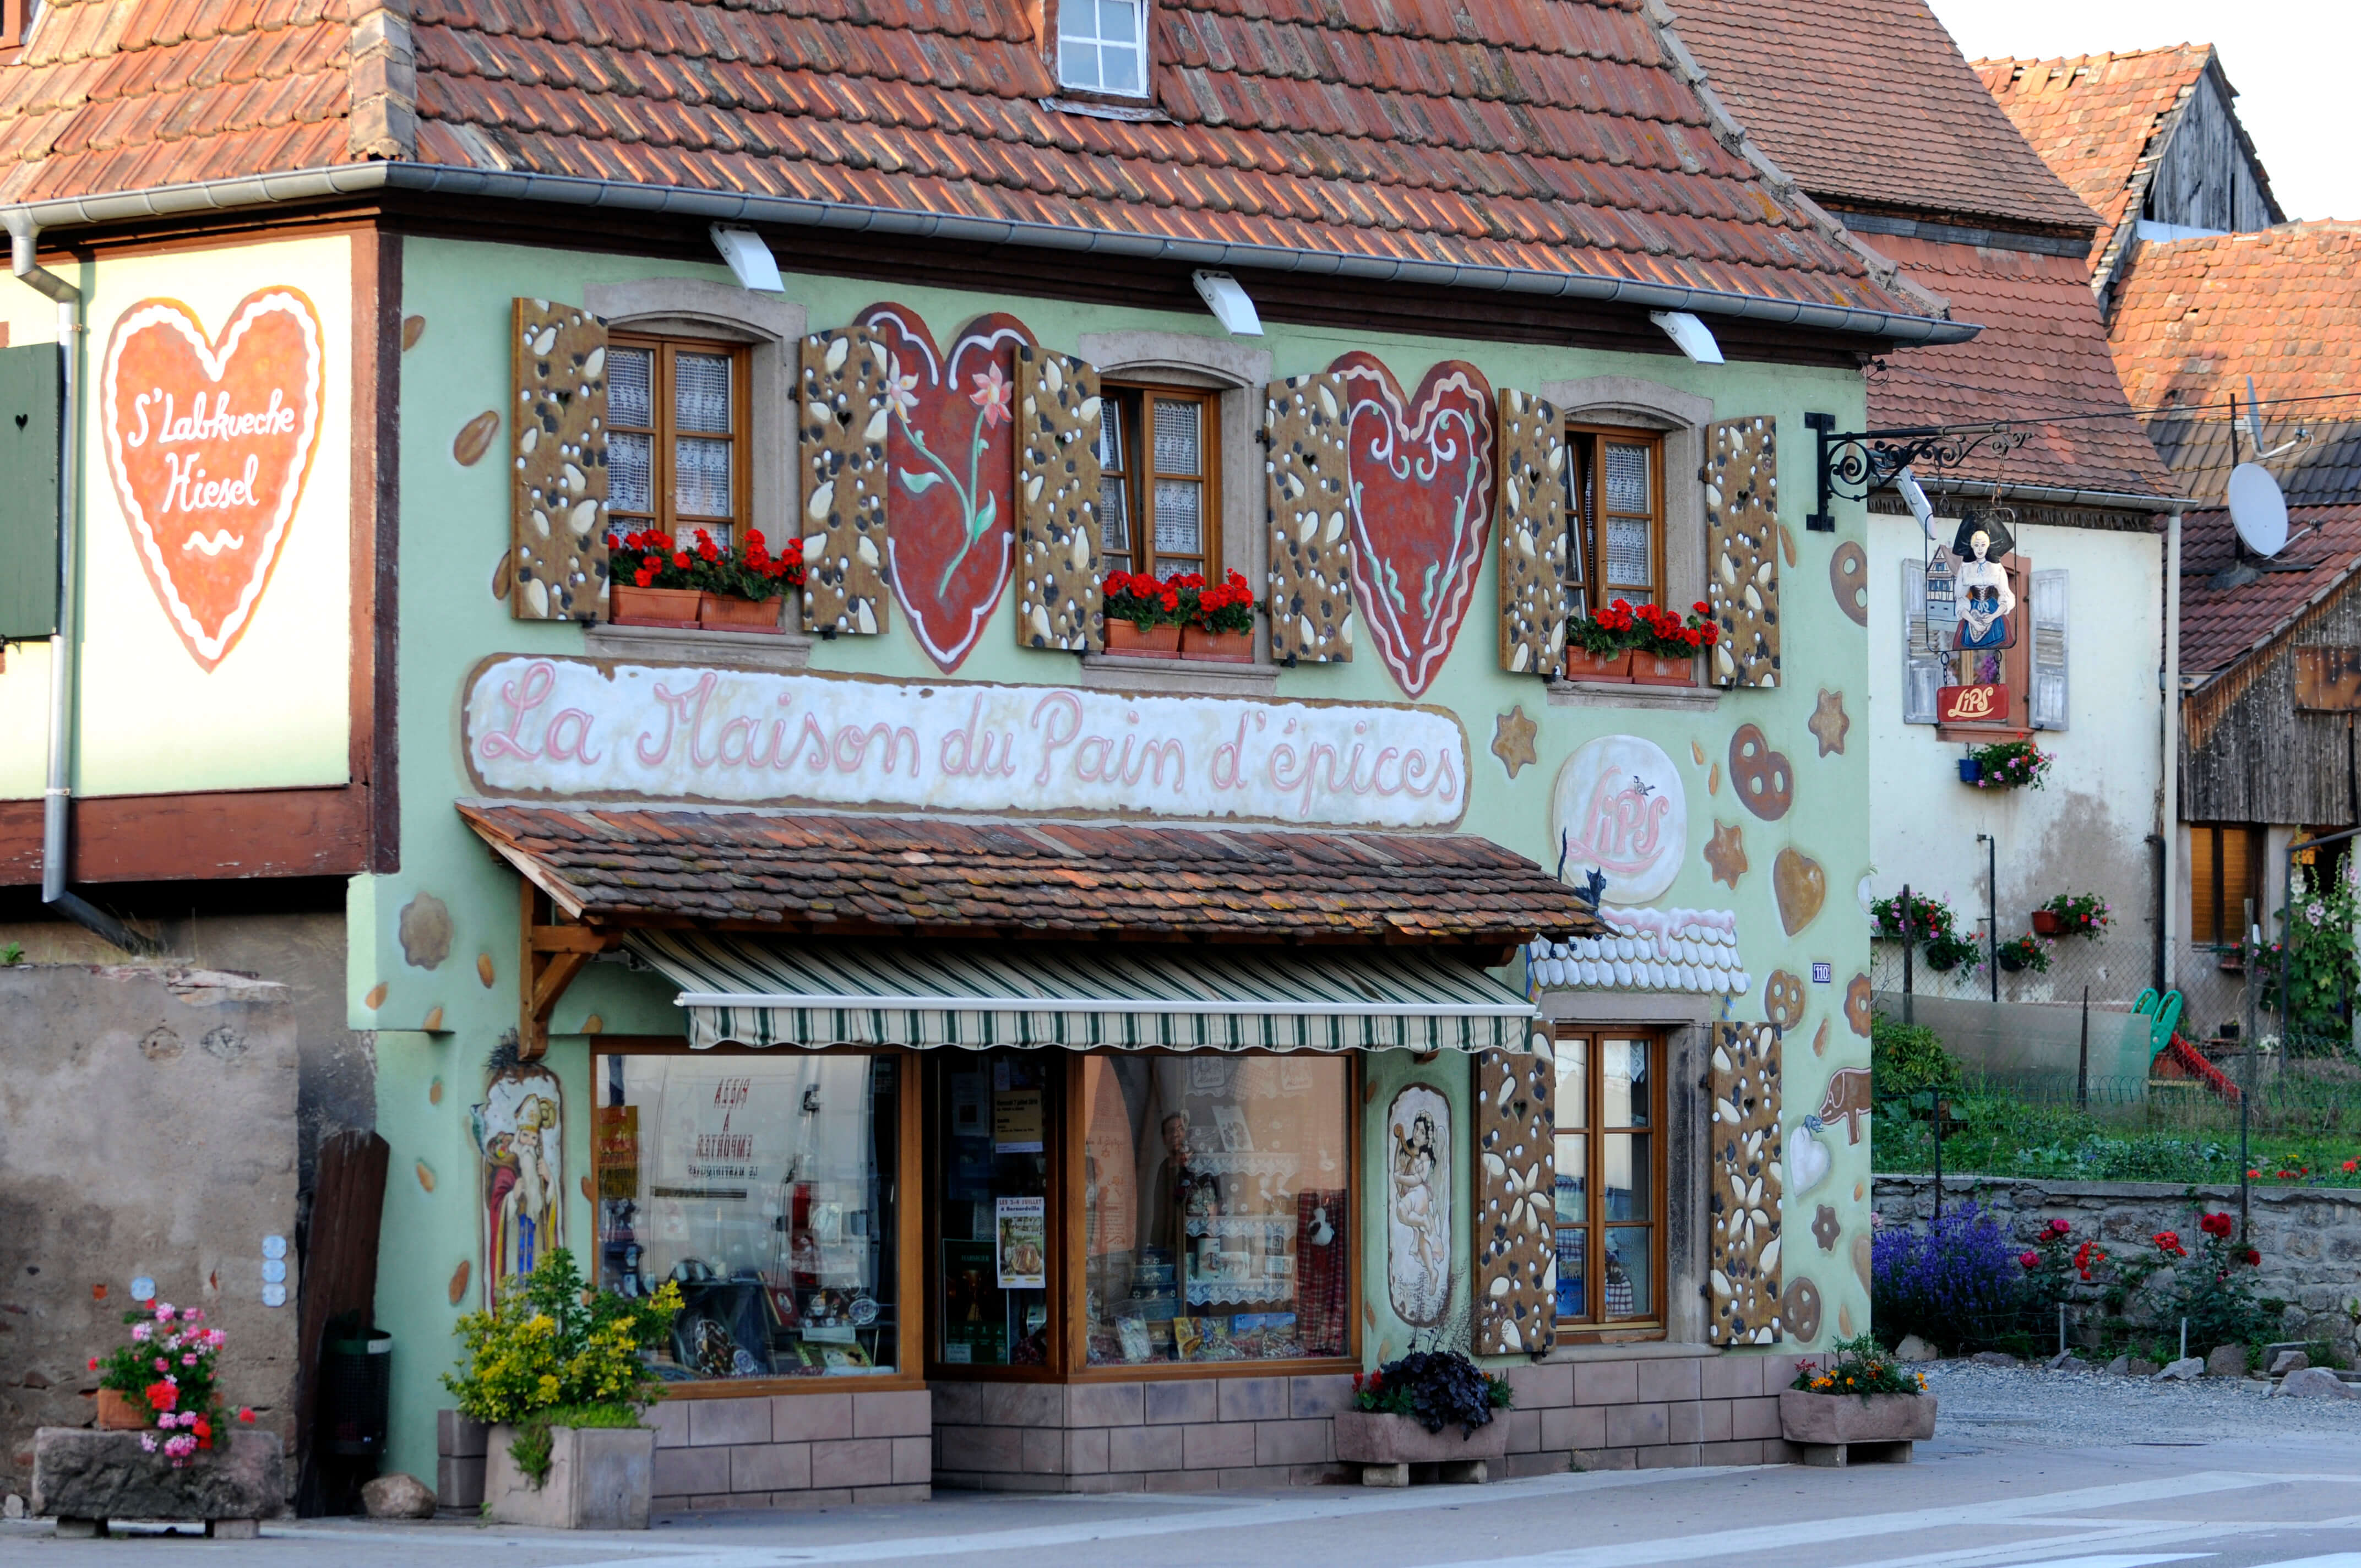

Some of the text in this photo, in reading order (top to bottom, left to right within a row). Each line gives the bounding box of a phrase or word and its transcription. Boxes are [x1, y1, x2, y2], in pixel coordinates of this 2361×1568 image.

[161, 452, 260, 513] Hiesel
[480, 661, 1457, 818] La Maison du Pain d'épices
[1815, 967, 1827, 979] 110
